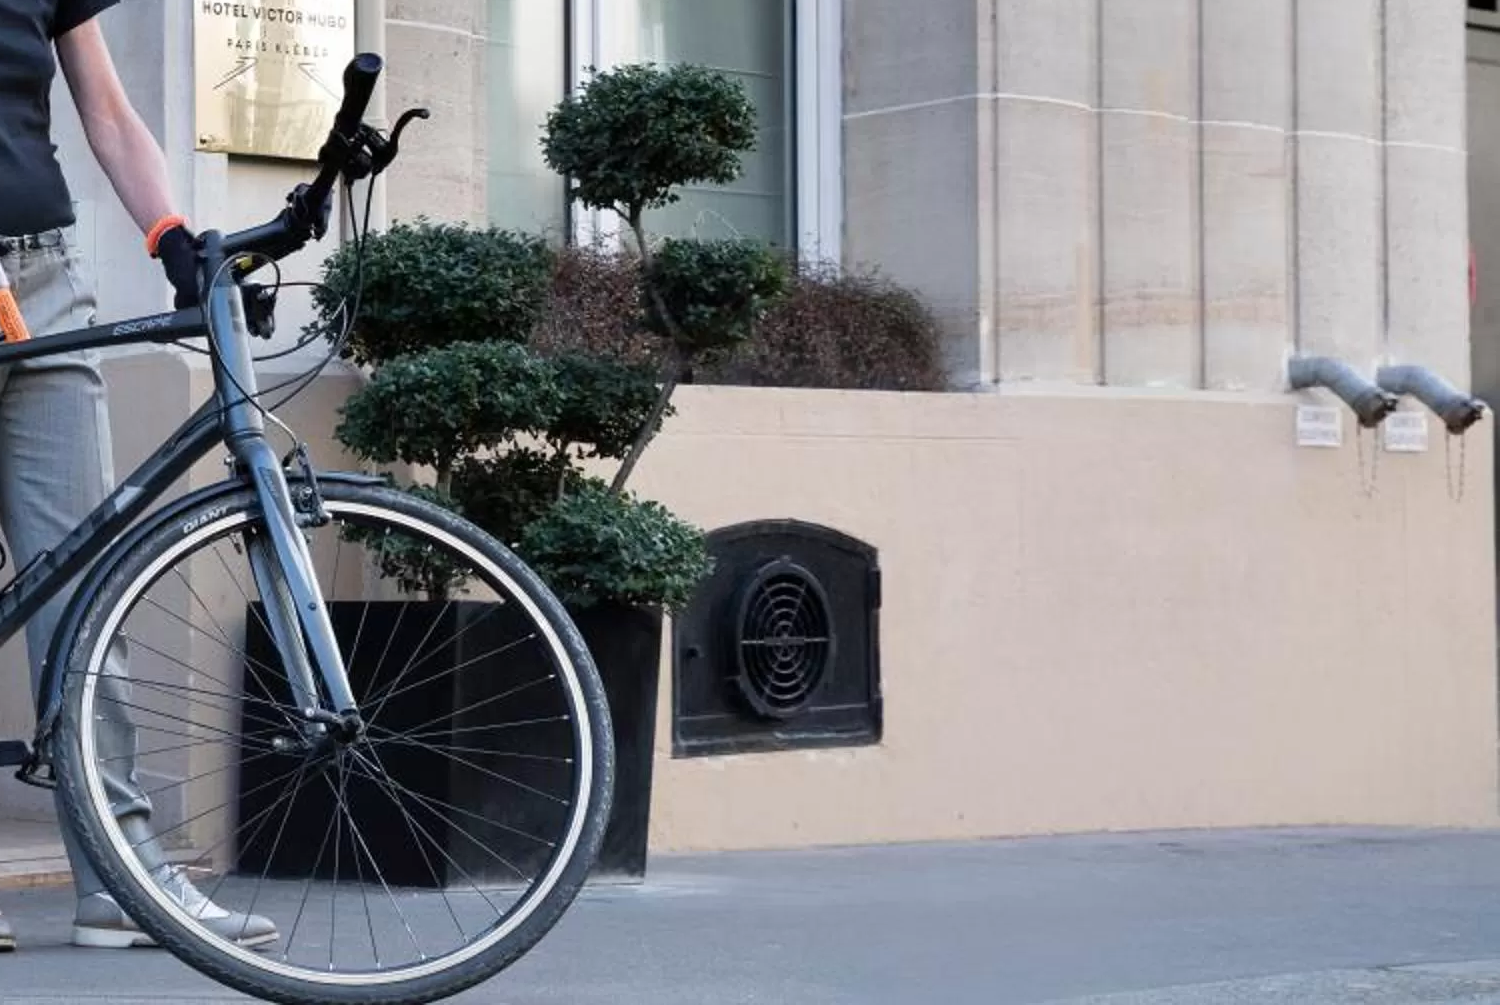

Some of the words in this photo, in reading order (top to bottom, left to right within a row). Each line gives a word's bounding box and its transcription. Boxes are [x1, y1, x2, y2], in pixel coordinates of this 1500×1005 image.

[202, 1, 248, 19] HOTEL
[253, 6, 303, 24] VICTOR
[307, 13, 348, 30] HUGO
[227, 38, 267, 52] PARIS
[183, 505, 229, 535] GIANT
